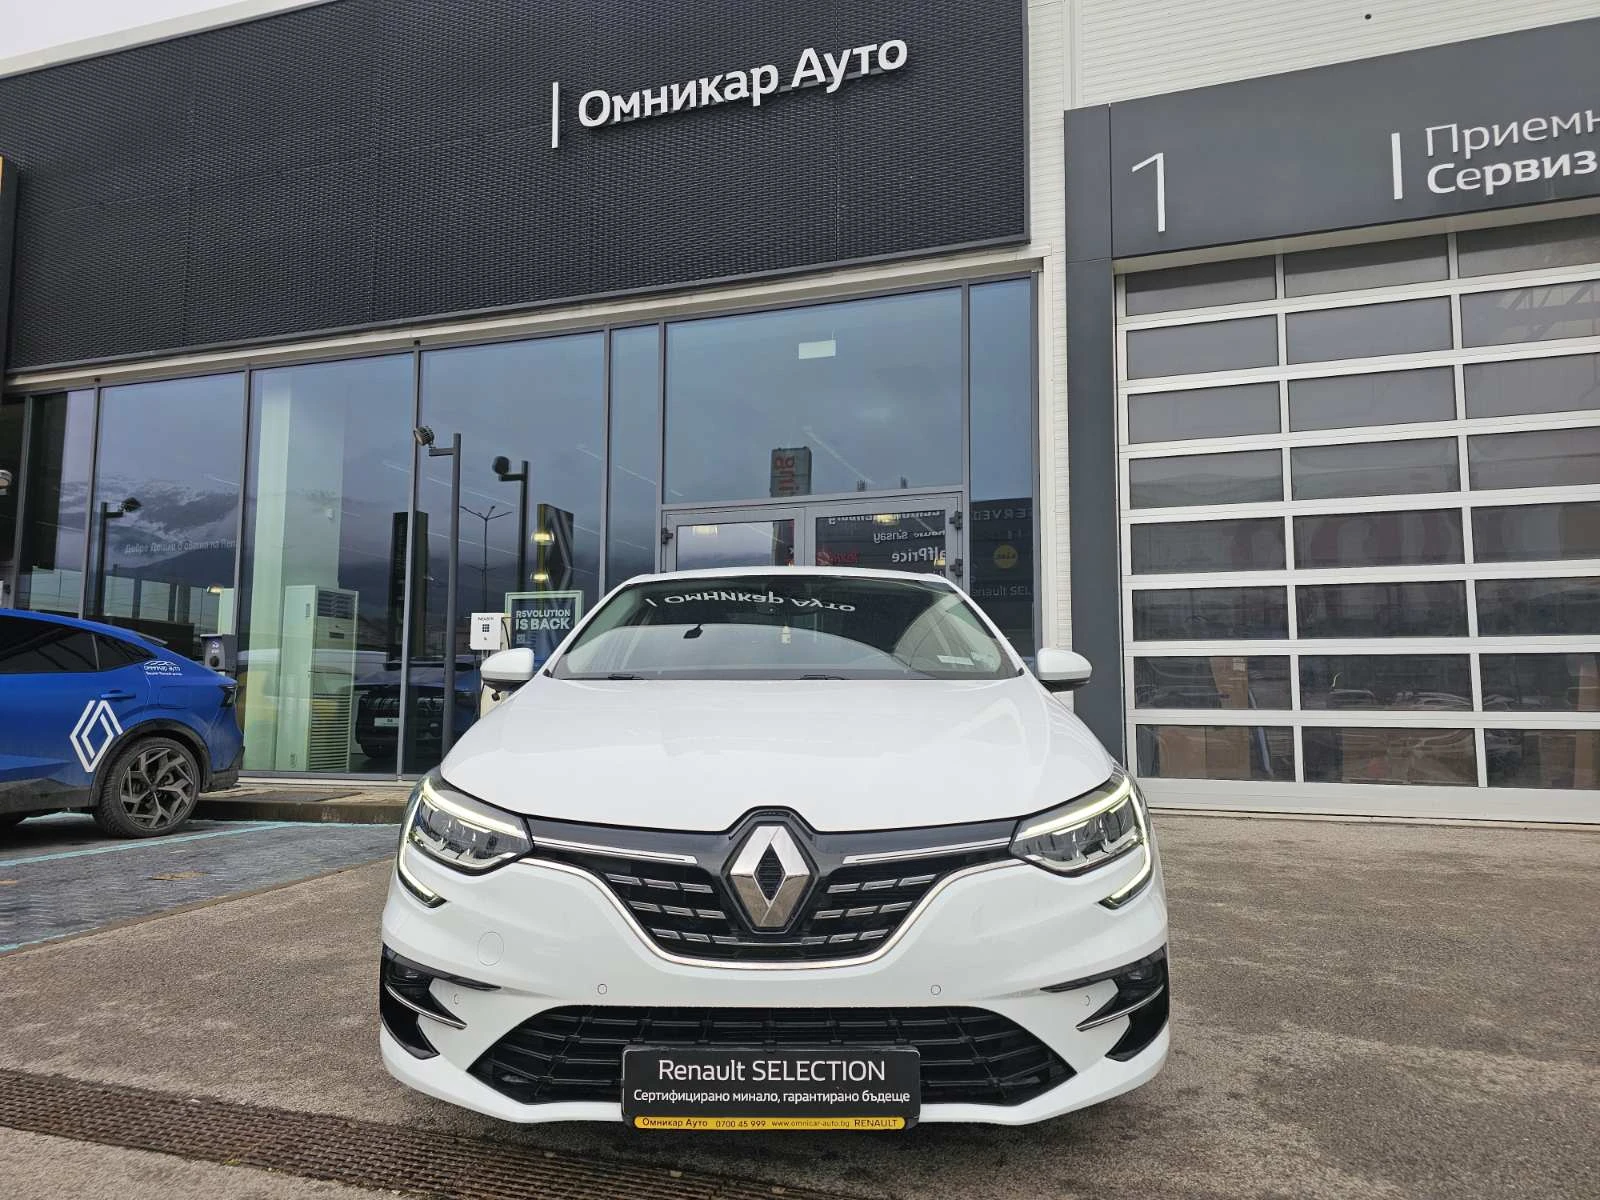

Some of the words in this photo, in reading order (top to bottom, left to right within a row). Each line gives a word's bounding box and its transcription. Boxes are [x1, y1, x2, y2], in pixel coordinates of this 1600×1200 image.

[578, 63, 779, 127] Омникар
[791, 39, 908, 94] Ауто
[1426, 150, 1598, 195] Сервиз
[1131, 152, 1166, 232] 1
[515, 618, 529, 630] IS
[530, 617, 570, 630] BACK
[658, 1059, 746, 1081] Renault
[752, 1060, 886, 1081] SELECTION
[633, 1089, 730, 1104] Сертифицирано
[732, 1092, 781, 1103] минало,
[783, 1091, 859, 1104] гарантирано
[862, 1090, 911, 1104] бъдеще
[642, 1117, 683, 1128] Омникар
[685, 1118, 708, 1128] Ауто
[715, 1119, 736, 1128] 0700
[738, 1119, 748, 1128] 45
[854, 1118, 898, 1128] RENAULT
